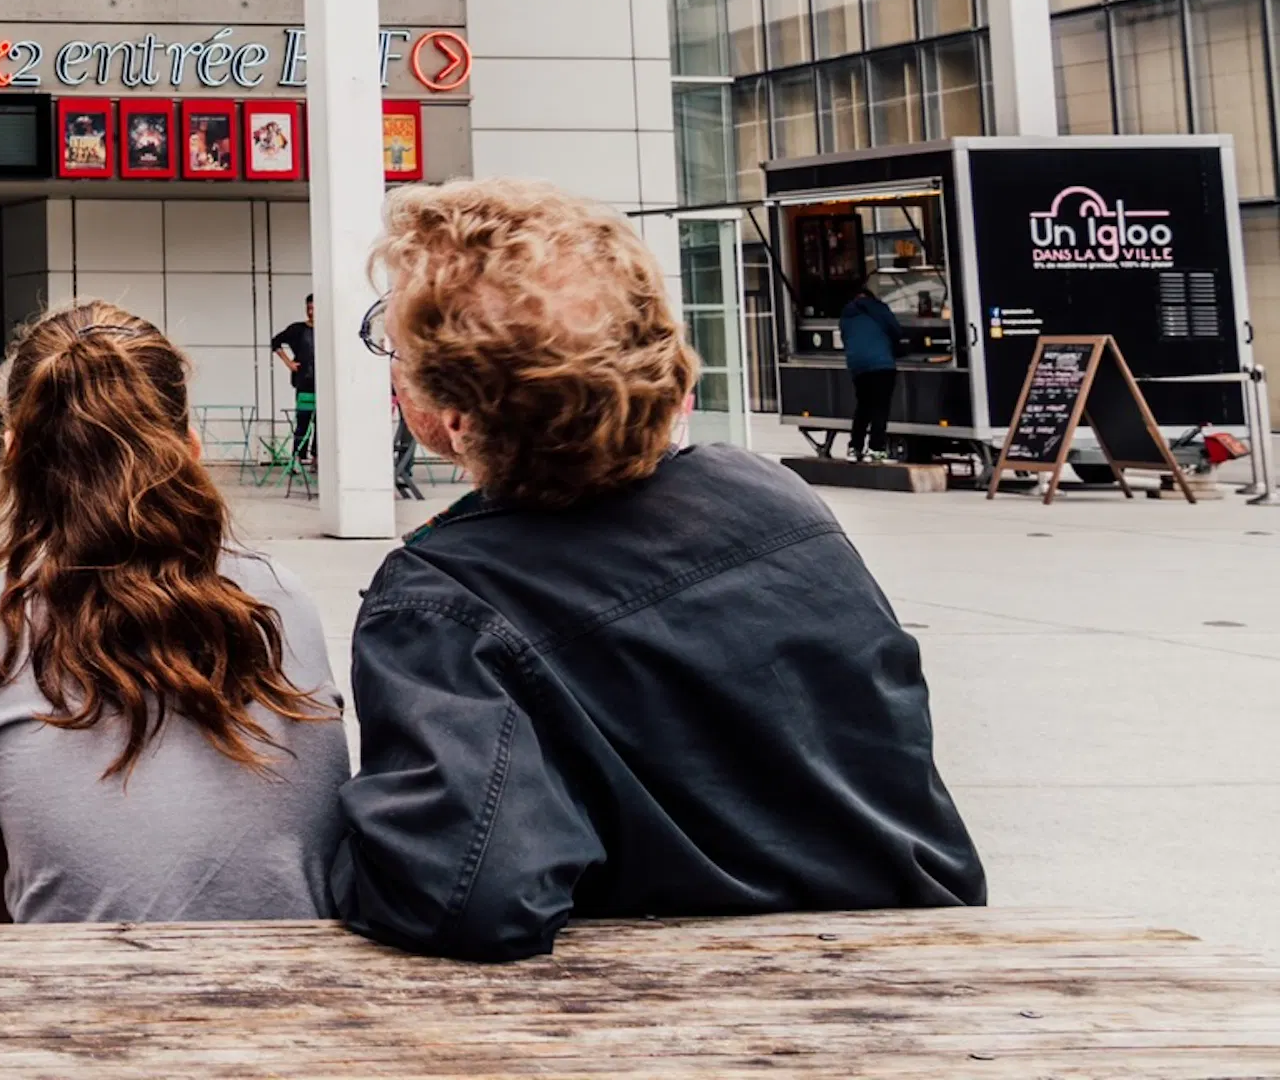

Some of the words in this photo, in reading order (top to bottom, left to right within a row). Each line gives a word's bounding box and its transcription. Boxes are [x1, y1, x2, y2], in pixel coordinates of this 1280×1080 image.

[55, 27, 269, 88] entrée
[1030, 217, 1077, 248] Un
[1087, 199, 1172, 262] Igloo
[1032, 248, 1072, 261] DANS
[1074, 248, 1096, 261] LA
[1122, 247, 1173, 261] VILLE
